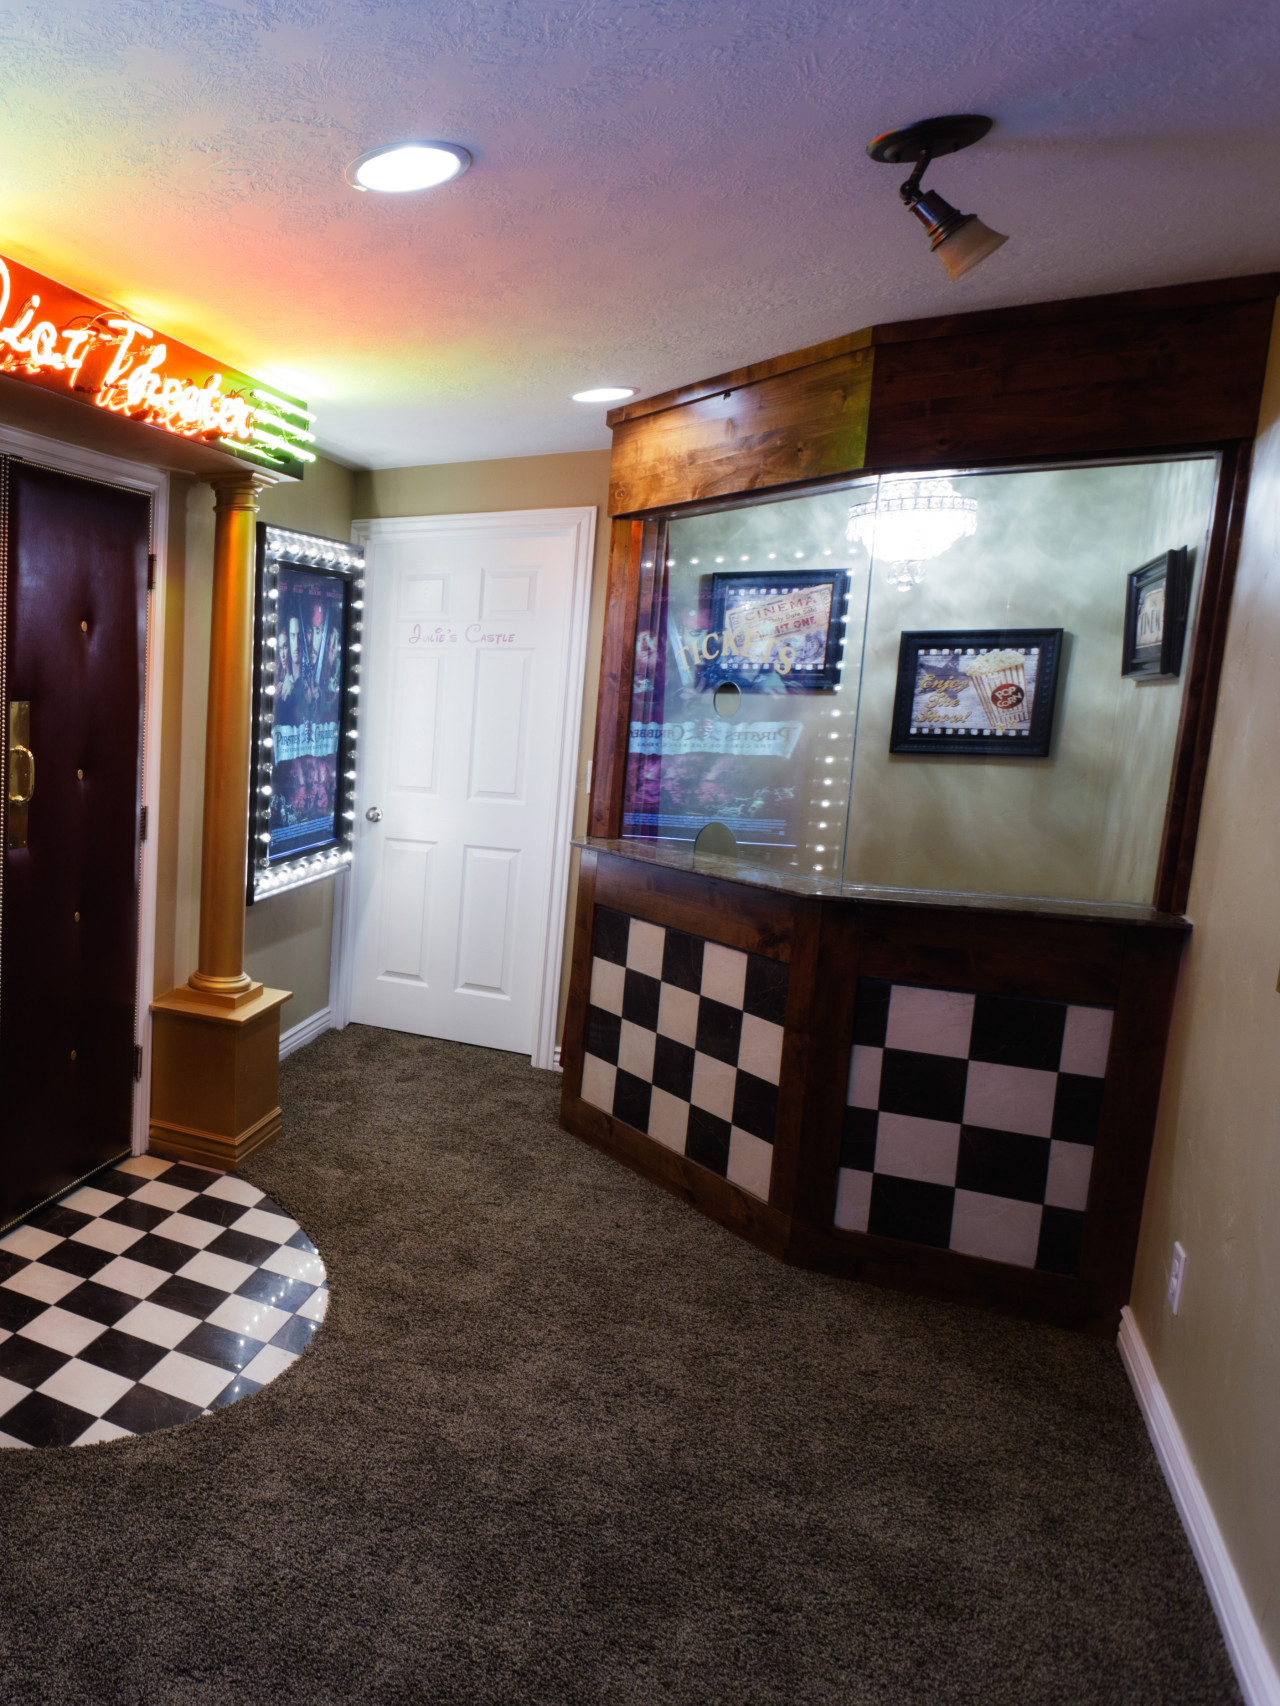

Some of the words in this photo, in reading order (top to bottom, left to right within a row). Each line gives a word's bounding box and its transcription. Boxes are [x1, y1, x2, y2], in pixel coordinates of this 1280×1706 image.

[745, 596, 816, 621] CINEMA
[793, 616, 816, 629] ONE
[675, 629, 797, 675] TICKETS
[918, 674, 970, 693] Enjoy
[995, 686, 1016, 699] POP
[997, 692, 1022, 707] CORN
[924, 694, 960, 709] The
[914, 709, 972, 724] Show!
